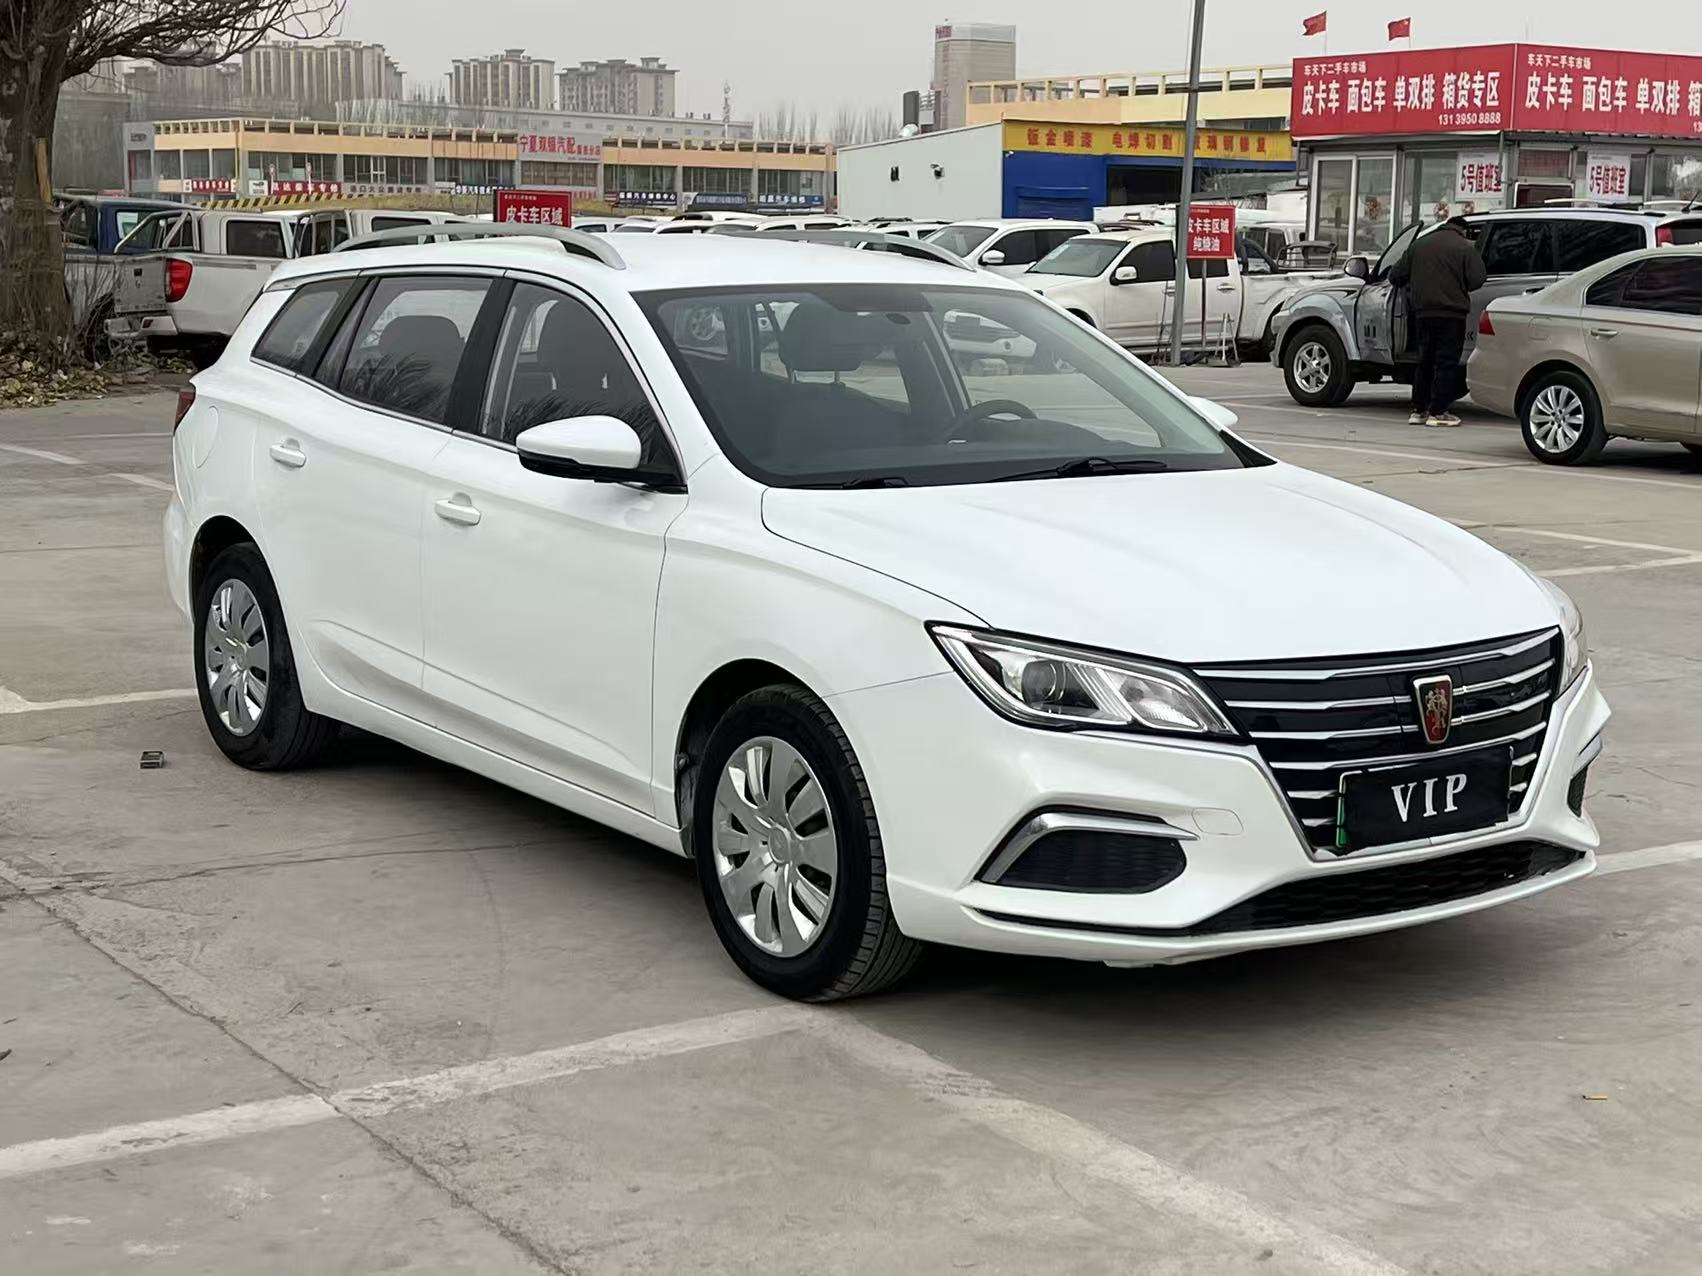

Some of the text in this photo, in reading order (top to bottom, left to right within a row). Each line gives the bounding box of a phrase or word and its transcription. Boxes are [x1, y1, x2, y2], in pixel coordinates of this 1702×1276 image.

[1304, 61, 1367, 76] 车天下二手车市场
[1527, 53, 1591, 69] 车天下二手车市场
[1302, 71, 1500, 115] 皮卡车 面包车 单双排 箱货专区
[1525, 71, 1573, 111] 皮卡车
[1582, 75, 1627, 113] 面包车
[1635, 77, 1680, 115] 单双排
[1438, 112, 1500, 125] 131 3950 8888
[1461, 163, 1503, 193] 5号值班室
[1589, 165, 1626, 194] 5号值班室
[506, 204, 563, 225] 皮卡车区域
[1391, 773, 1467, 822] VIP
